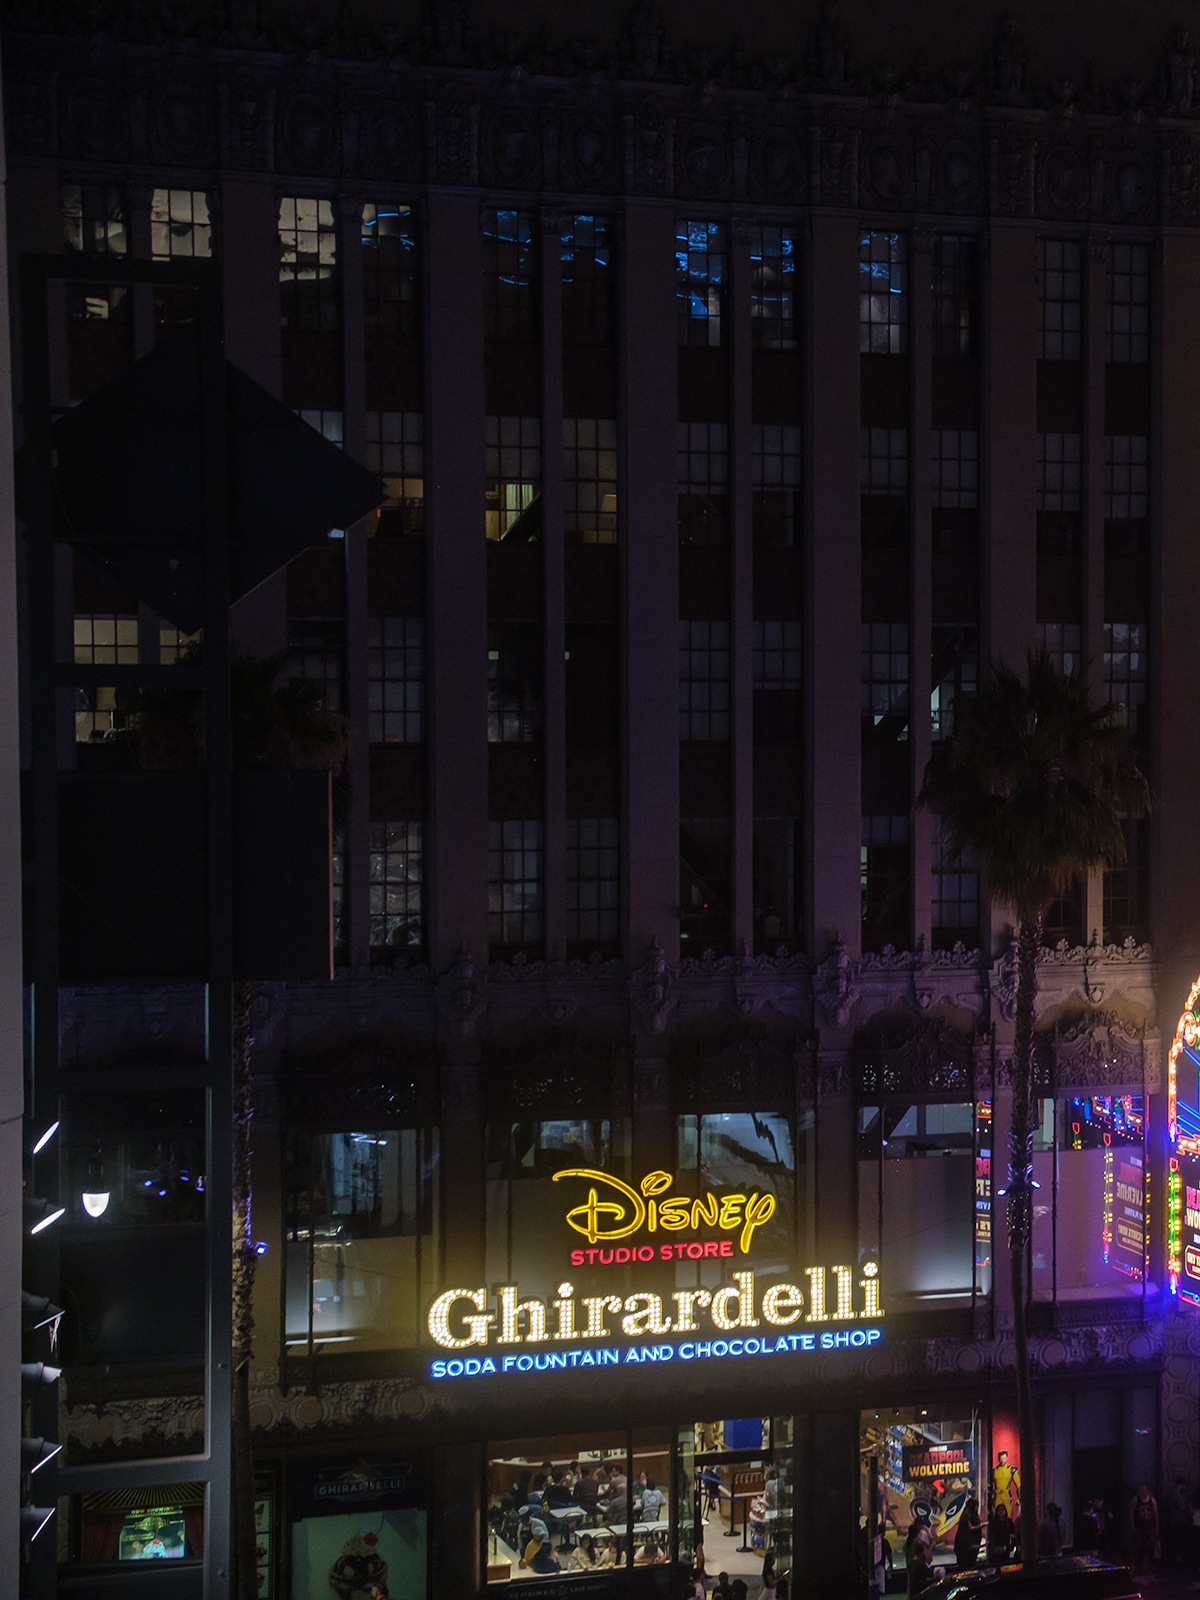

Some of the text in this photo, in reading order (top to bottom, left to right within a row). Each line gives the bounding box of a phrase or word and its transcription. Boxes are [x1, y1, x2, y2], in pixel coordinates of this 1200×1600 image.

[552, 1168, 776, 1254] Disney
[570, 1240, 734, 1266] STUDIO STORE
[427, 1261, 885, 1349] Ghirardelli
[431, 1328, 881, 1379] SODA FOUNTAIN AND CHOCOLATE SHOP
[908, 1461, 970, 1478] WOLVERINE
